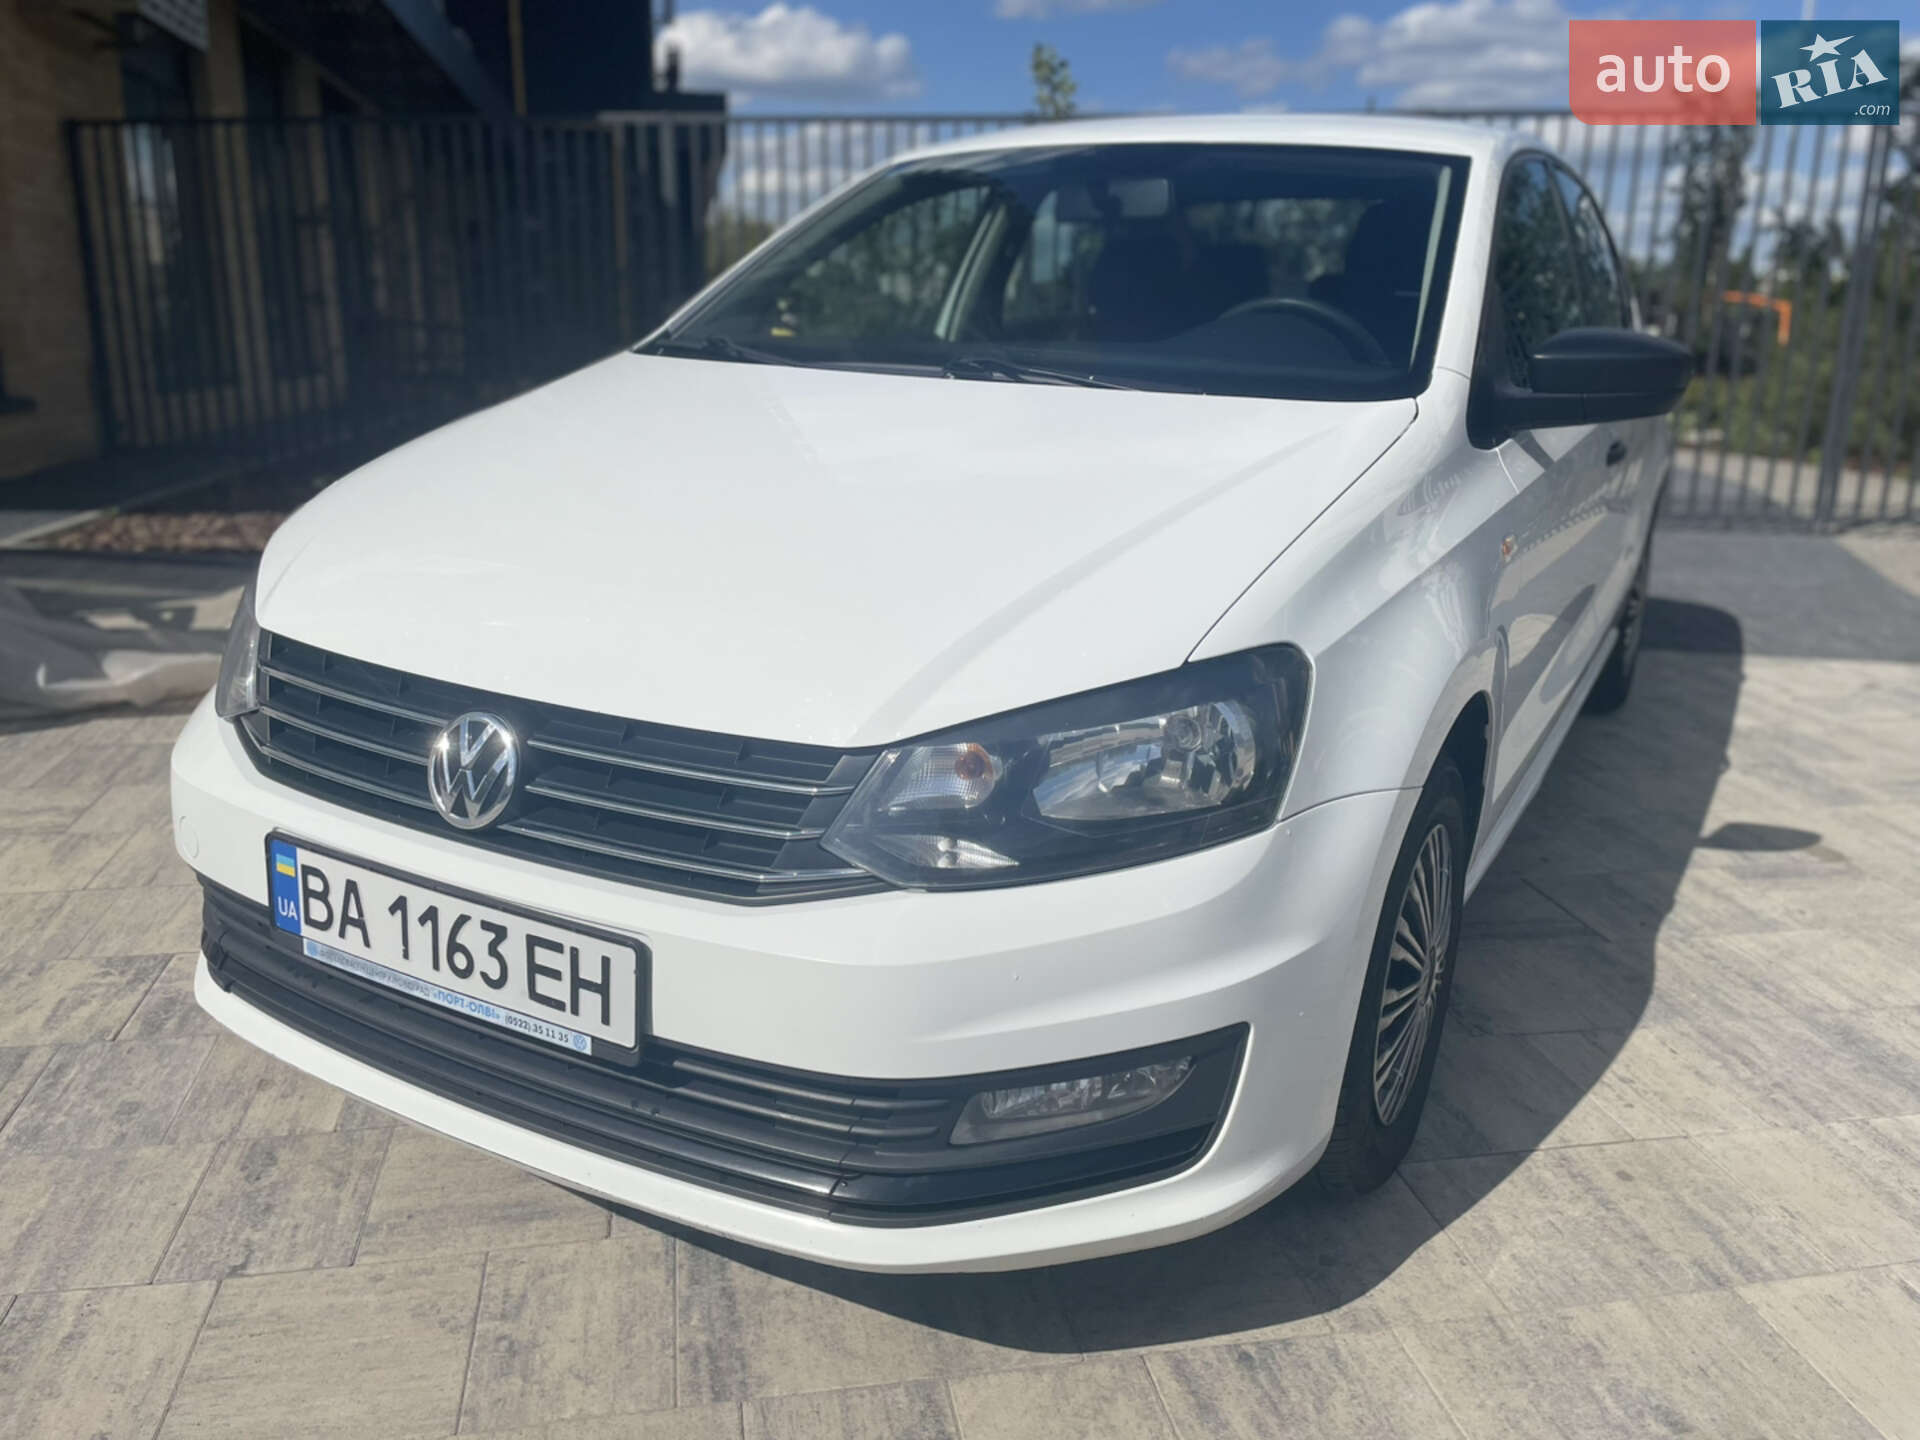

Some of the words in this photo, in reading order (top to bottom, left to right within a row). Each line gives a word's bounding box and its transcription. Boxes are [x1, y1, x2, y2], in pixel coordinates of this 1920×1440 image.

[278, 896, 299, 920] UA
[300, 864, 371, 948] BA
[387, 894, 508, 990] 1163
[525, 933, 611, 1026] EH
[545, 1027, 555, 1039] 11
